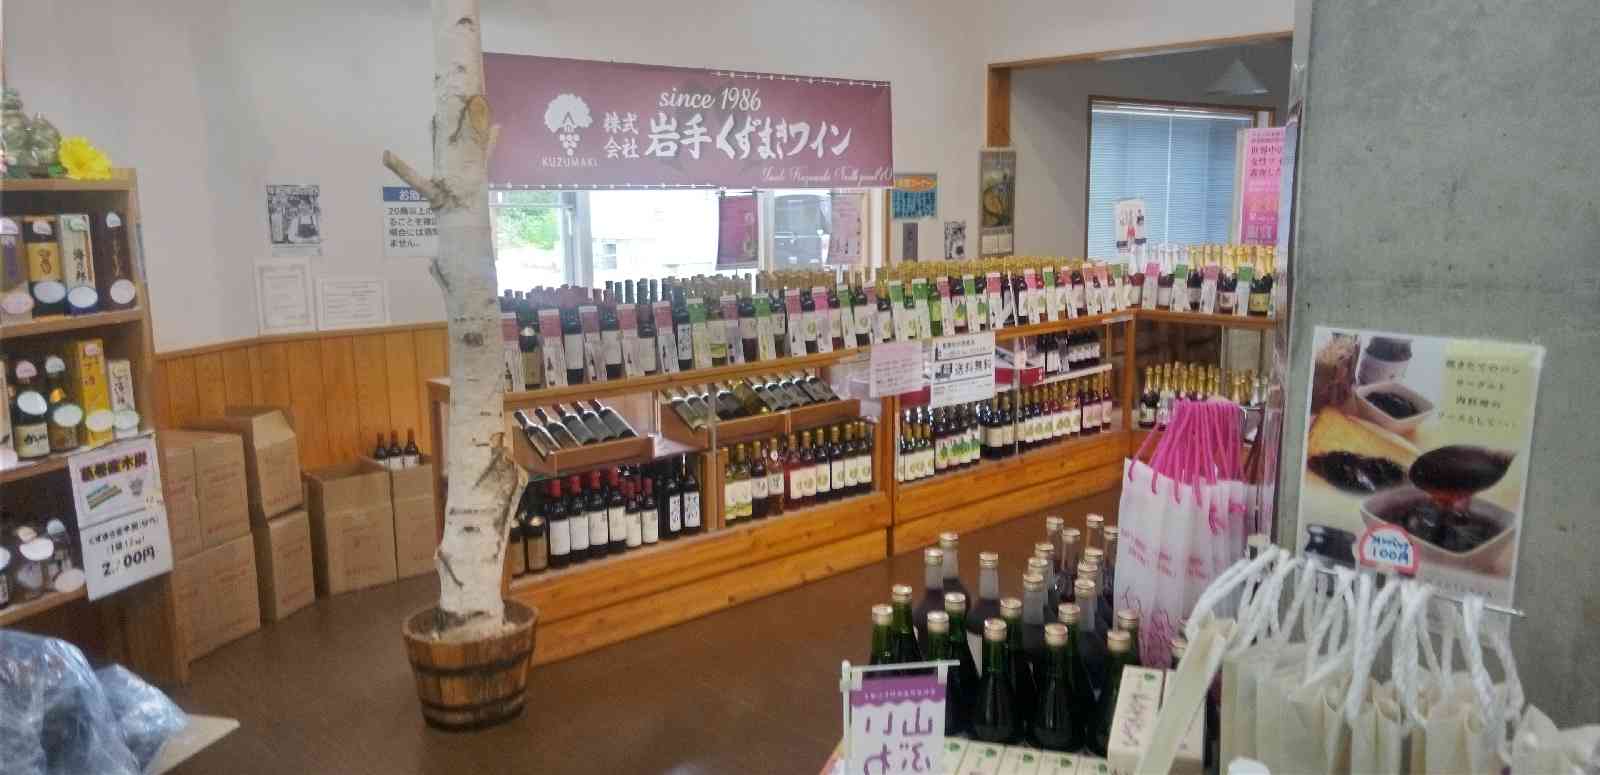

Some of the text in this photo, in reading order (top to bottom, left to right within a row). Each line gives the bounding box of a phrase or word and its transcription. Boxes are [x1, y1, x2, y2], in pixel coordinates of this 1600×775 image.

[658, 87, 762, 111] since 1986
[603, 111, 640, 134] 株式
[603, 138, 641, 160] 会社
[541, 156, 599, 169] KUZUMAKI
